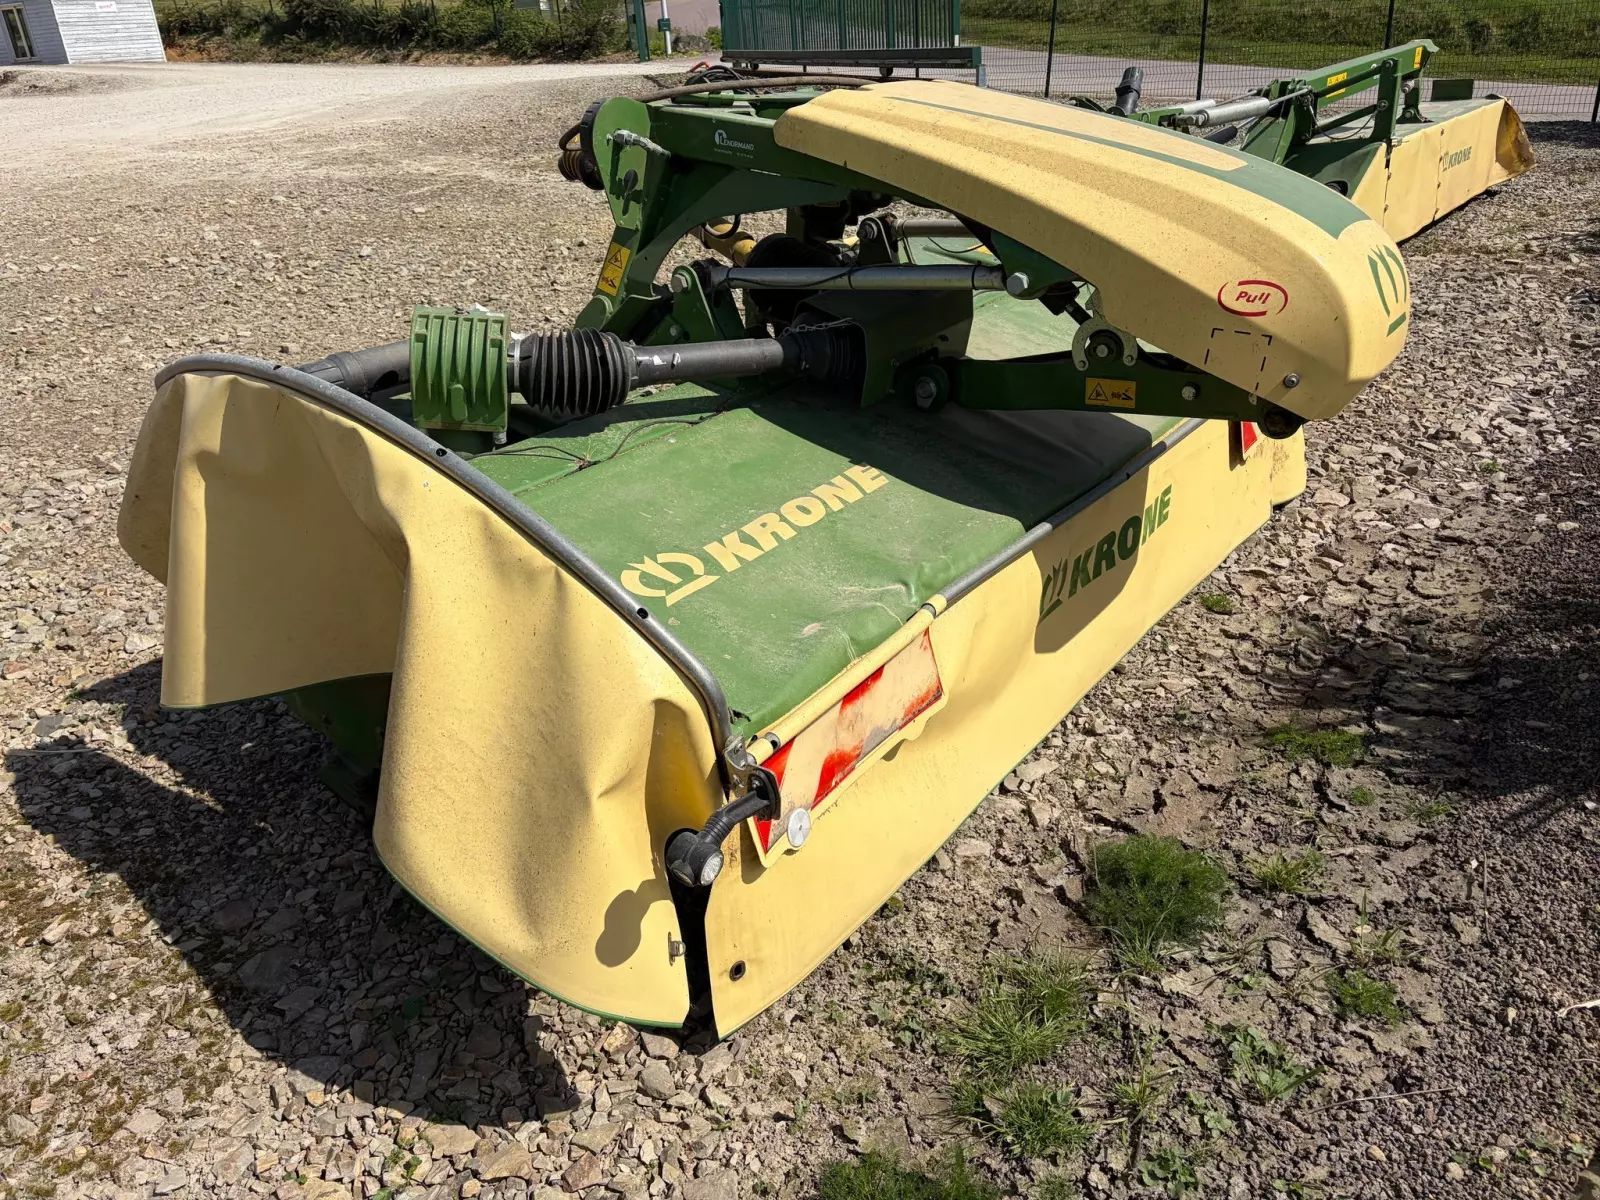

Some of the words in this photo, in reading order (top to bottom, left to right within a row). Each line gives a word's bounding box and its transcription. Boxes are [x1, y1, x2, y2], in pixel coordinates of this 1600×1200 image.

[1447, 145, 1472, 169] KRONE
[1235, 290, 1271, 305] Pull
[703, 463, 890, 573] KRONE
[1068, 483, 1172, 600] KRONE
